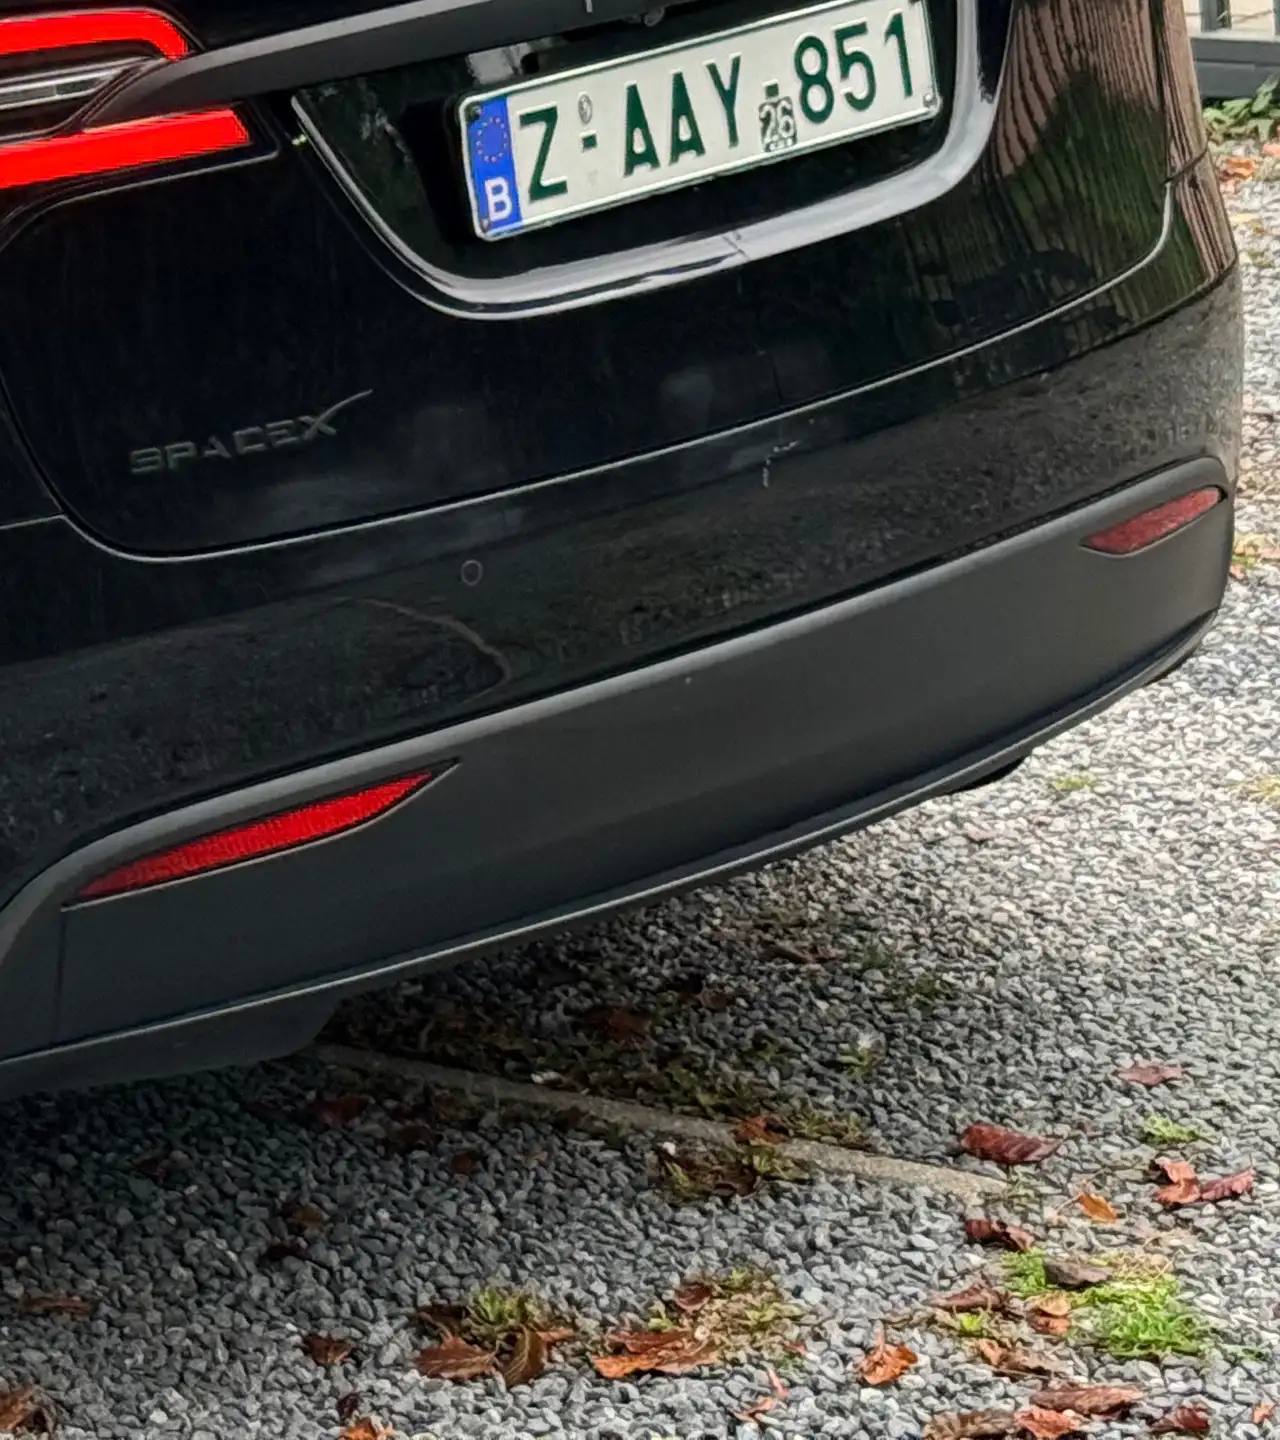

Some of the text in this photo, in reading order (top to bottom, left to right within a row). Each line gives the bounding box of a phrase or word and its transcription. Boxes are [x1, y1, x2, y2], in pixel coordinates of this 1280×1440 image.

[519, 11, 916, 203] Z-AAY-851
[484, 178, 513, 222] B
[130, 389, 373, 475] SPACEX
